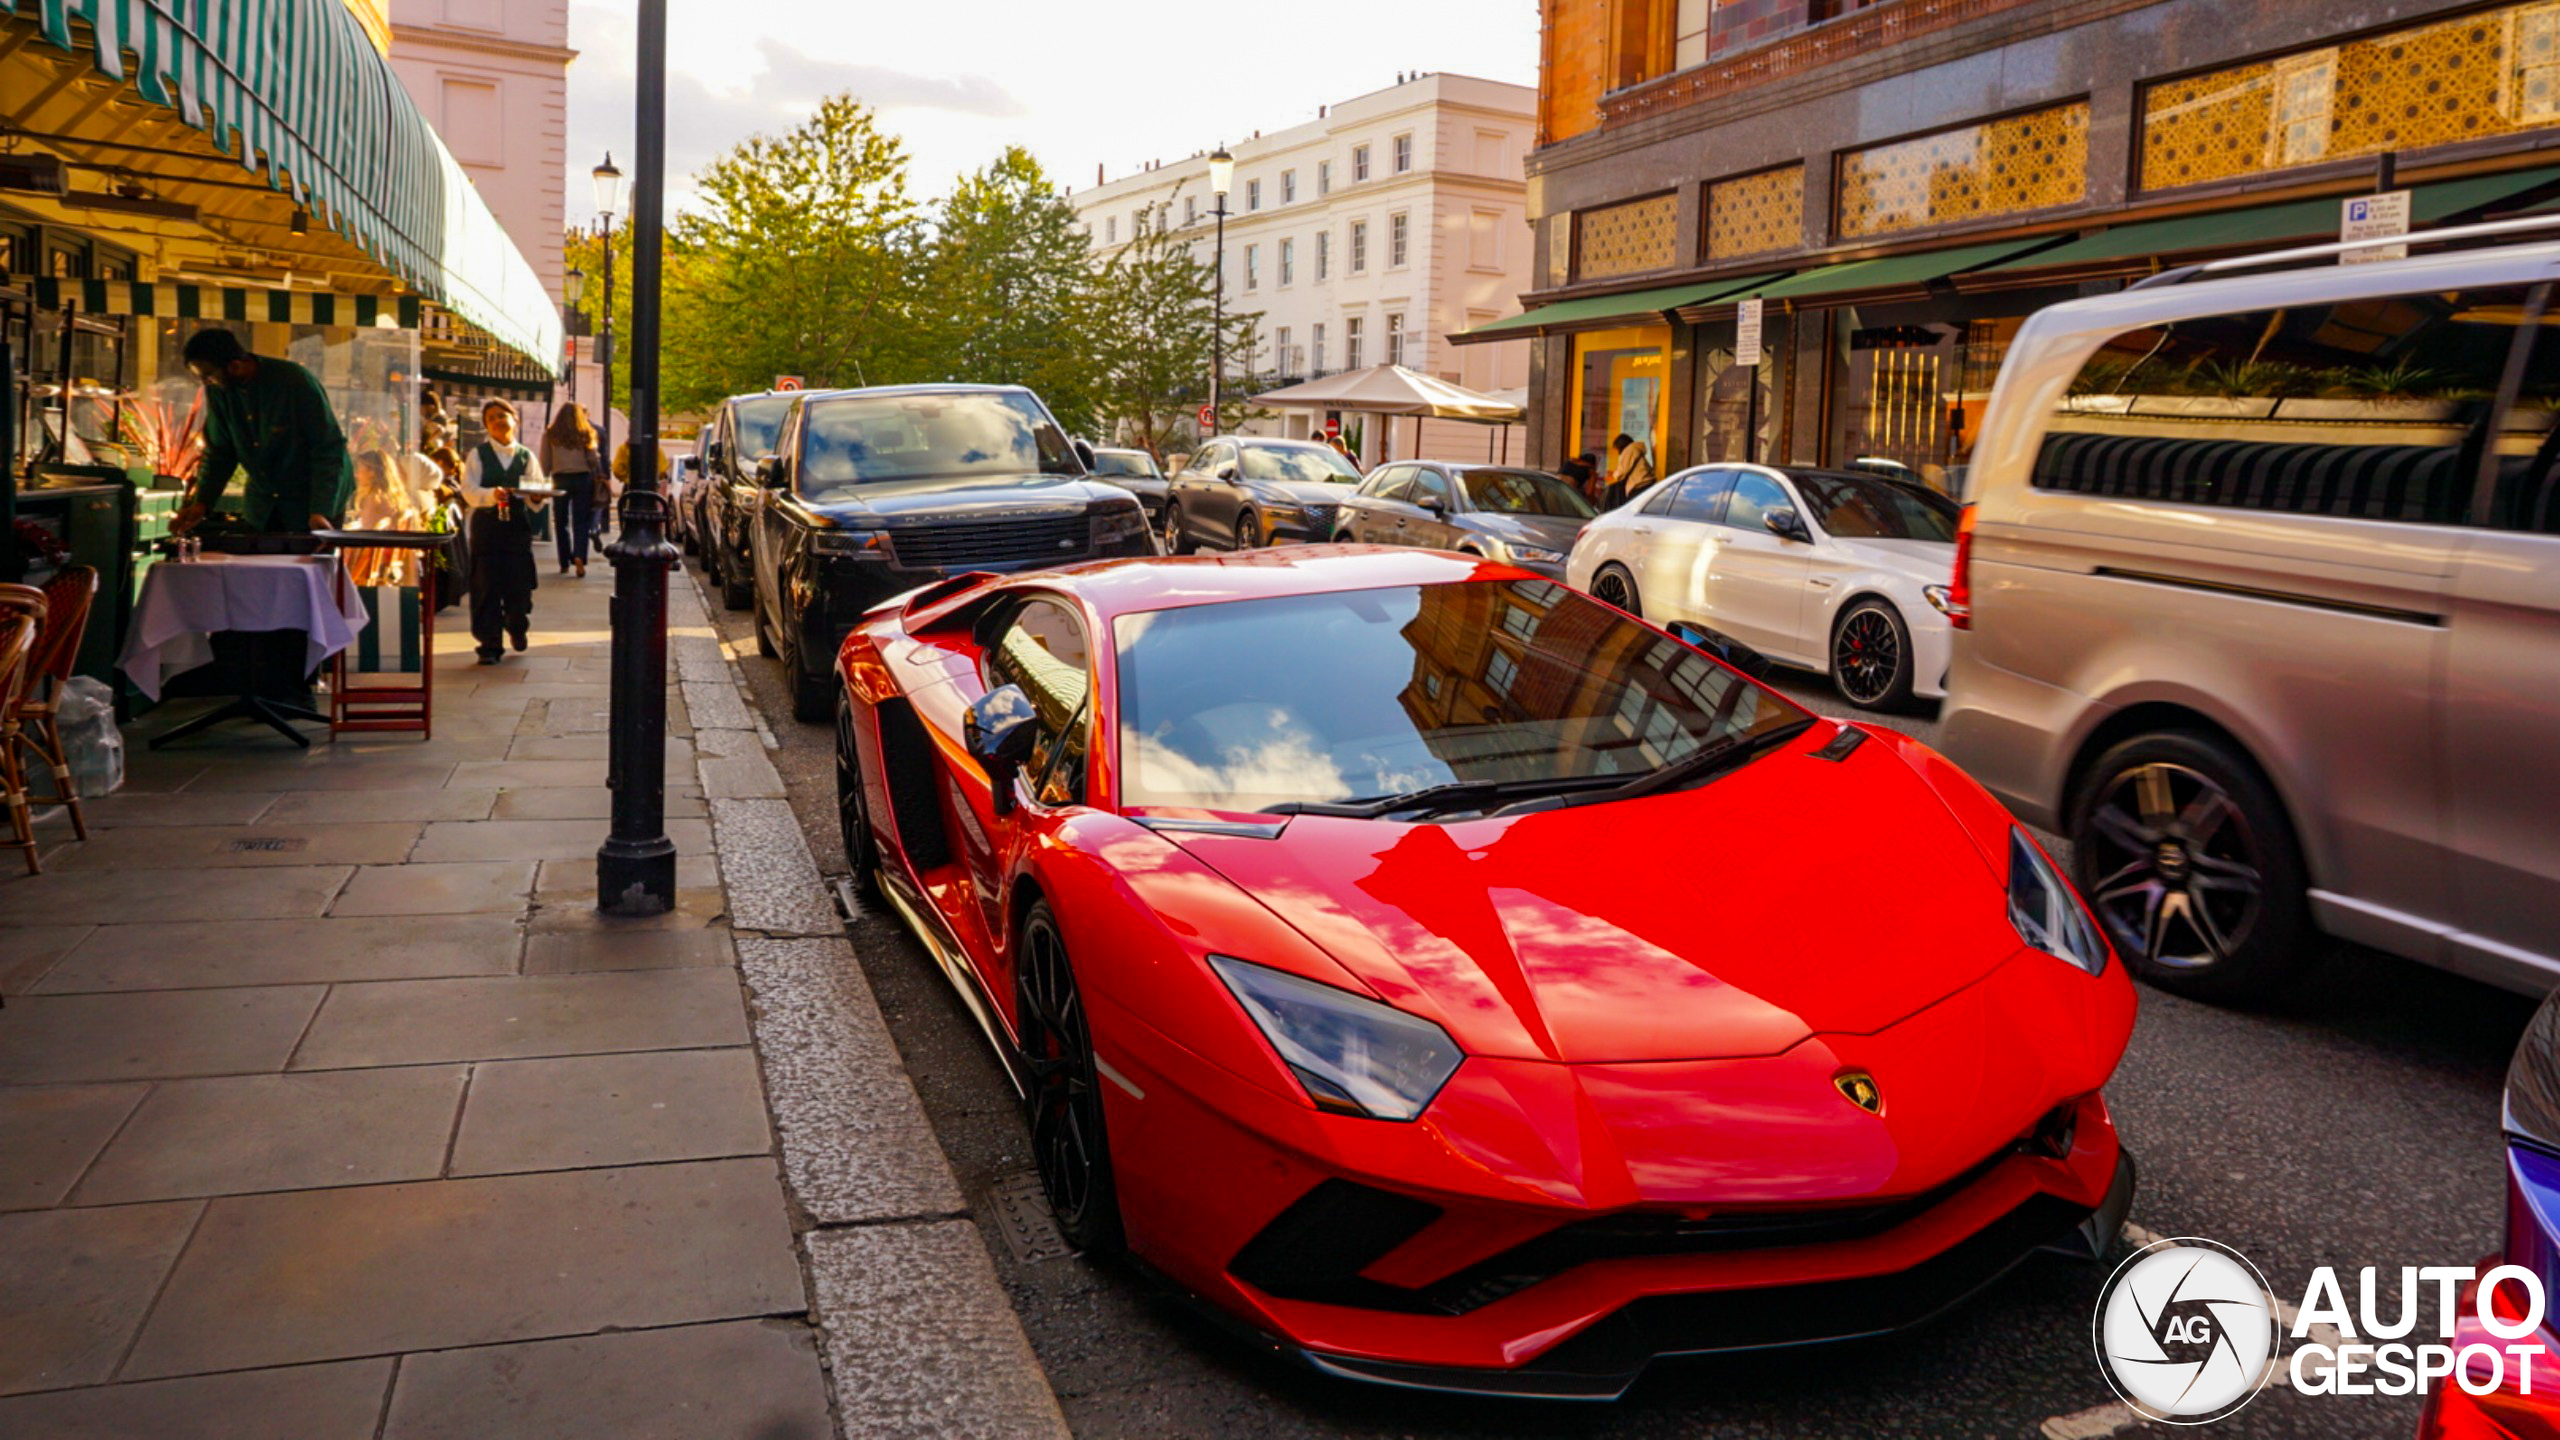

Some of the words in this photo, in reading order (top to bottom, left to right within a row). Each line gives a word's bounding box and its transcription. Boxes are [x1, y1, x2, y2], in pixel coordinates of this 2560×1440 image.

[2353, 204, 2366, 220] P
[904, 512, 983, 523] RANGE
[1000, 506, 1074, 517] ROVER
